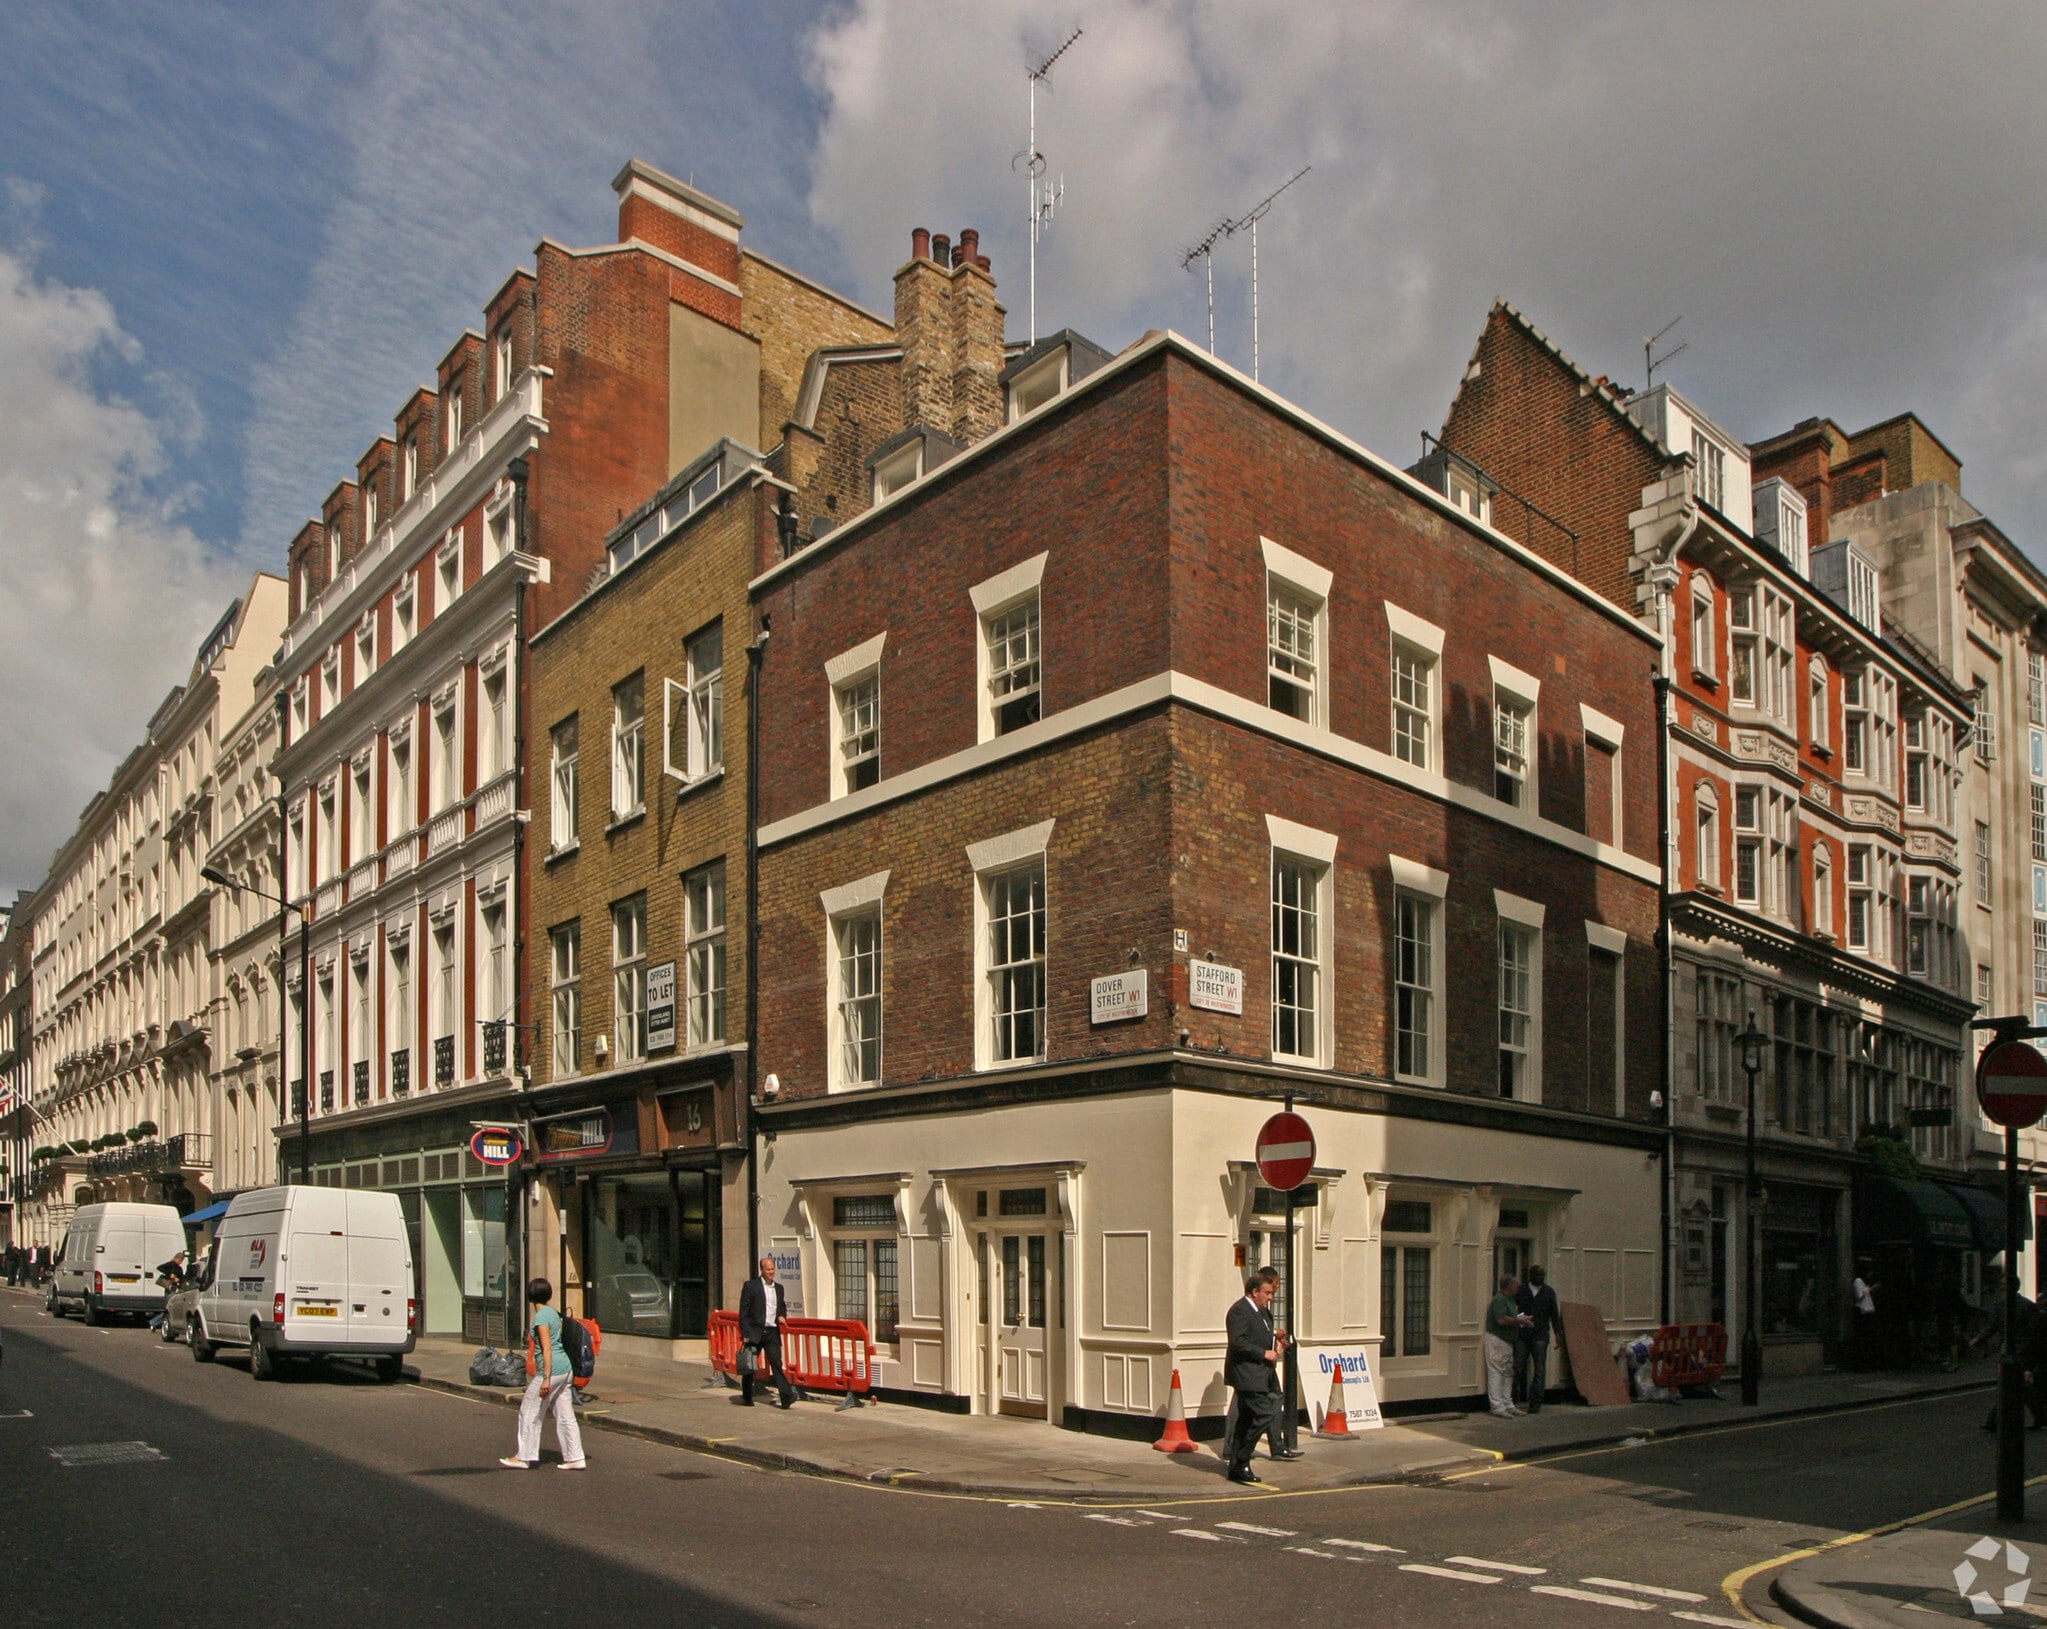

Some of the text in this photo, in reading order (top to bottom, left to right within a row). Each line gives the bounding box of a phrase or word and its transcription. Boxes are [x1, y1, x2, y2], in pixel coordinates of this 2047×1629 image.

[1176, 930, 1185, 947] H
[649, 967, 671, 982] OFFICES
[1196, 966, 1235, 984] STAFFORD
[648, 983, 674, 1003] TO LET
[1096, 978, 1122, 994] DOVER
[1196, 980, 1237, 999] STREET W1
[1096, 990, 1141, 1008] STREET W1
[687, 1103, 701, 1131] 16
[582, 1119, 605, 1145] HILL
[483, 1145, 510, 1159] HILL
